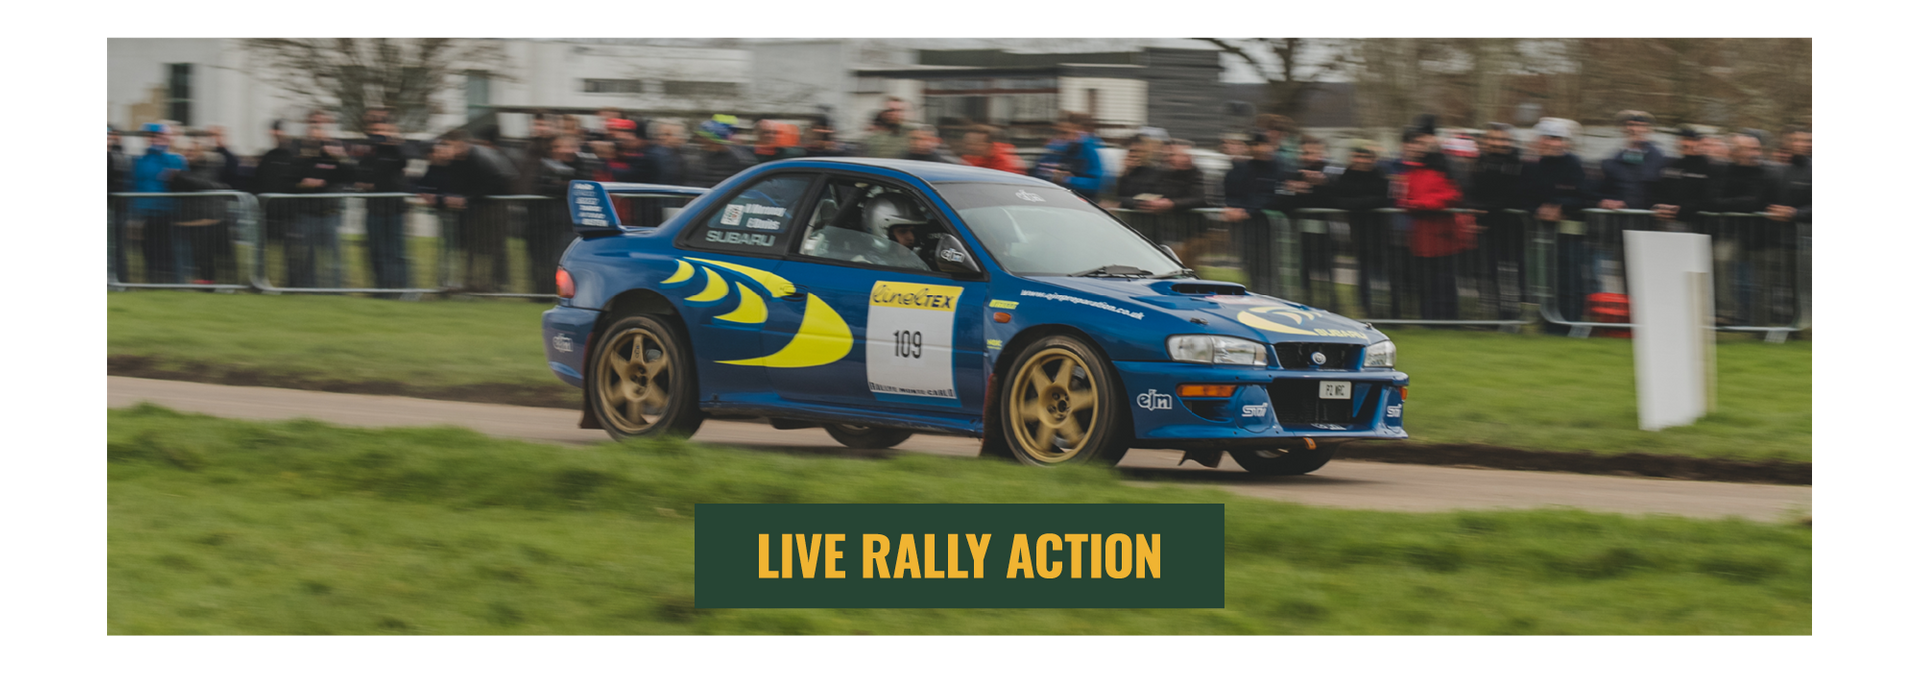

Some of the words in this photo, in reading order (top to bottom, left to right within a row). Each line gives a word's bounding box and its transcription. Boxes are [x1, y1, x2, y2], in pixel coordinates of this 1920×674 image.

[705, 230, 776, 247] SUBARU
[1313, 328, 1369, 340] SUBARU
[893, 330, 922, 359] 109
[1137, 389, 1172, 411] ejm
